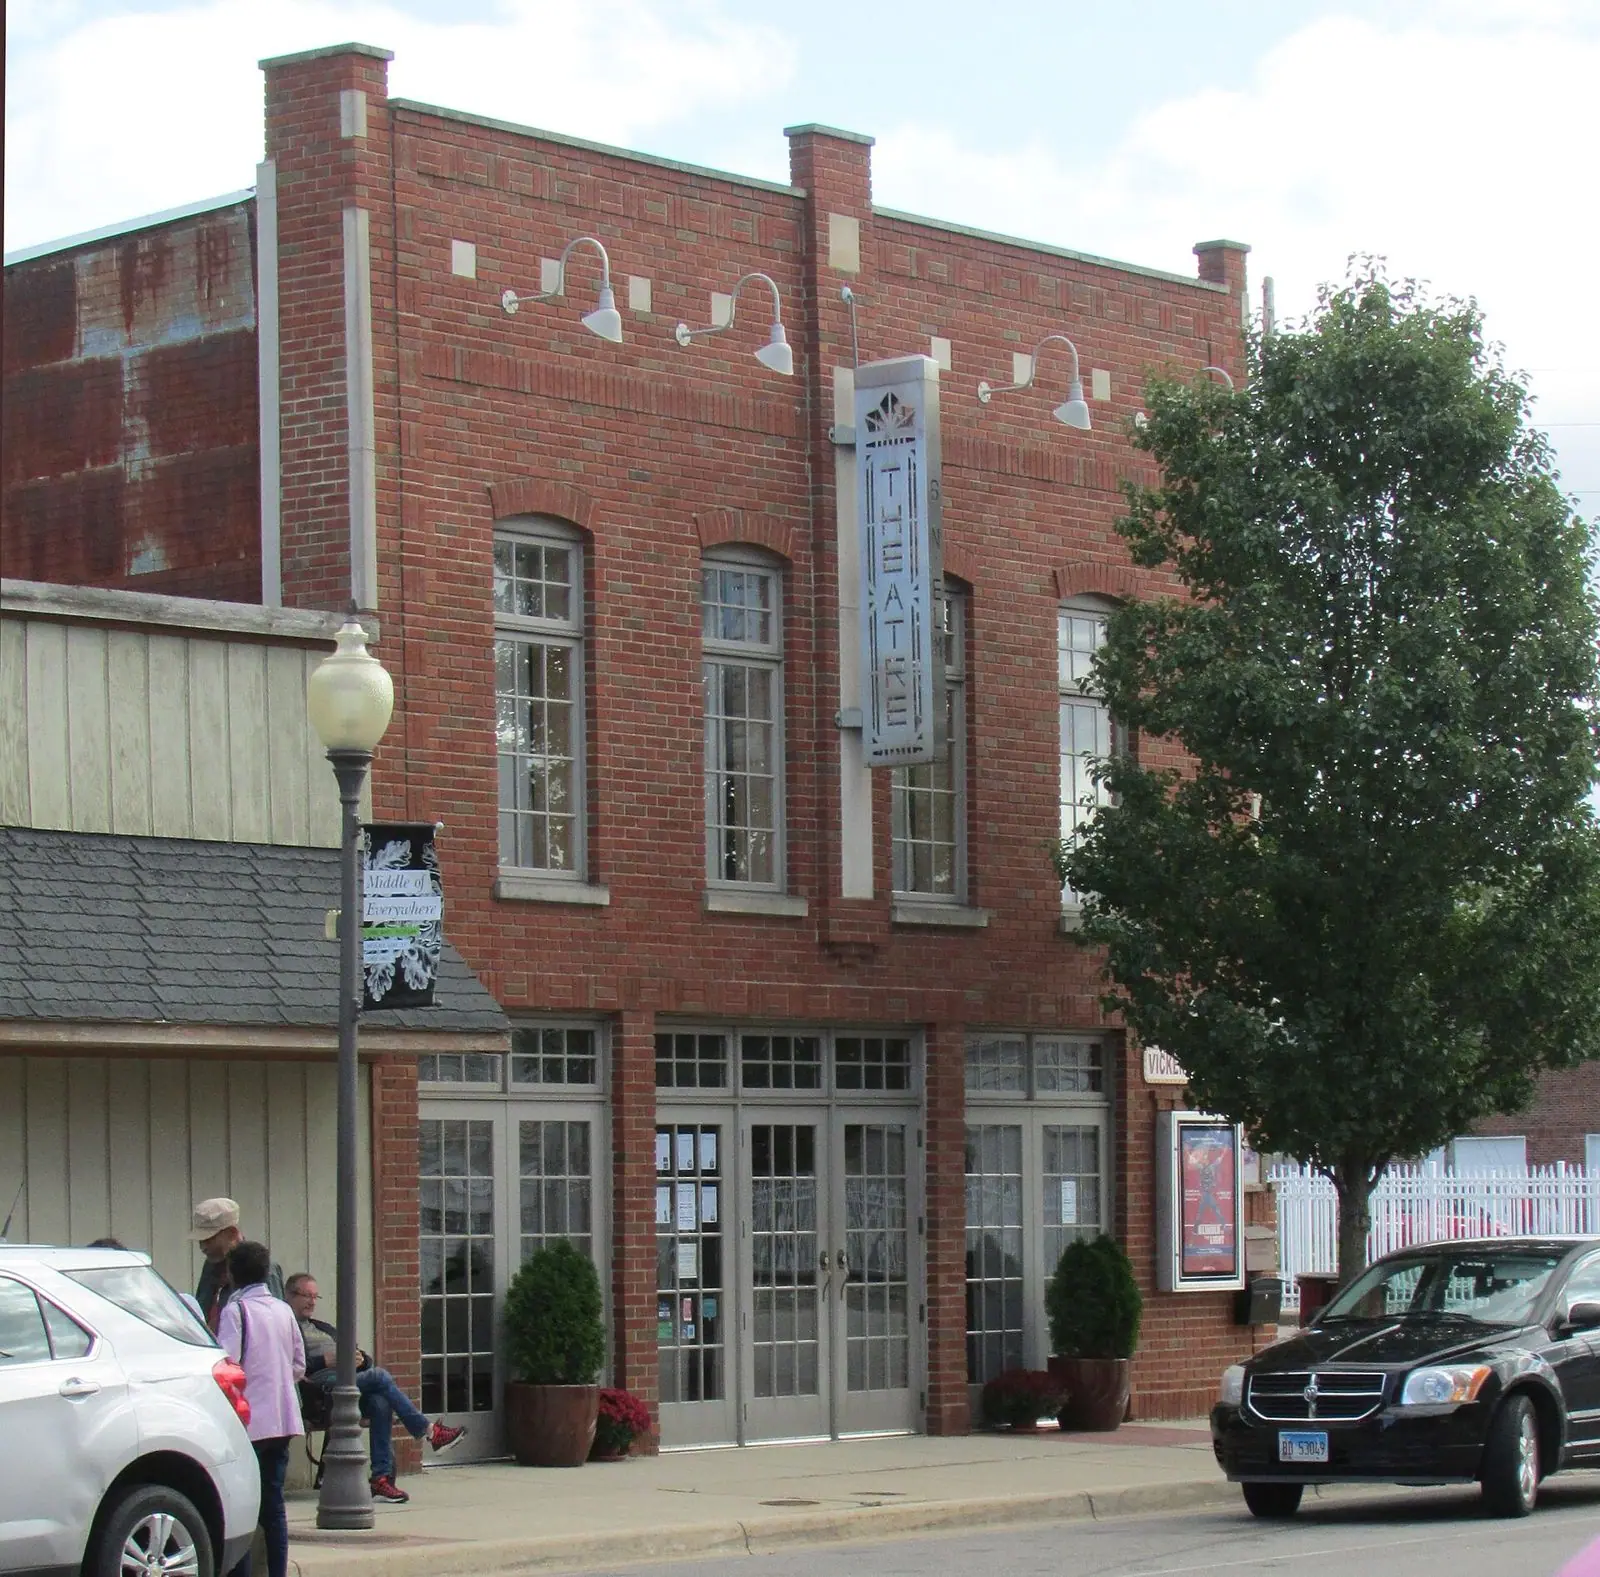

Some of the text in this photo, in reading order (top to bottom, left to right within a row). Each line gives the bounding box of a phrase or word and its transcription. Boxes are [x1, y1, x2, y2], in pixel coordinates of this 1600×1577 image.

[880, 466, 908, 726] THEATRE
[933, 577, 944, 658] ELM
[367, 874, 425, 892] Middle of
[367, 901, 437, 917] Everywhere
